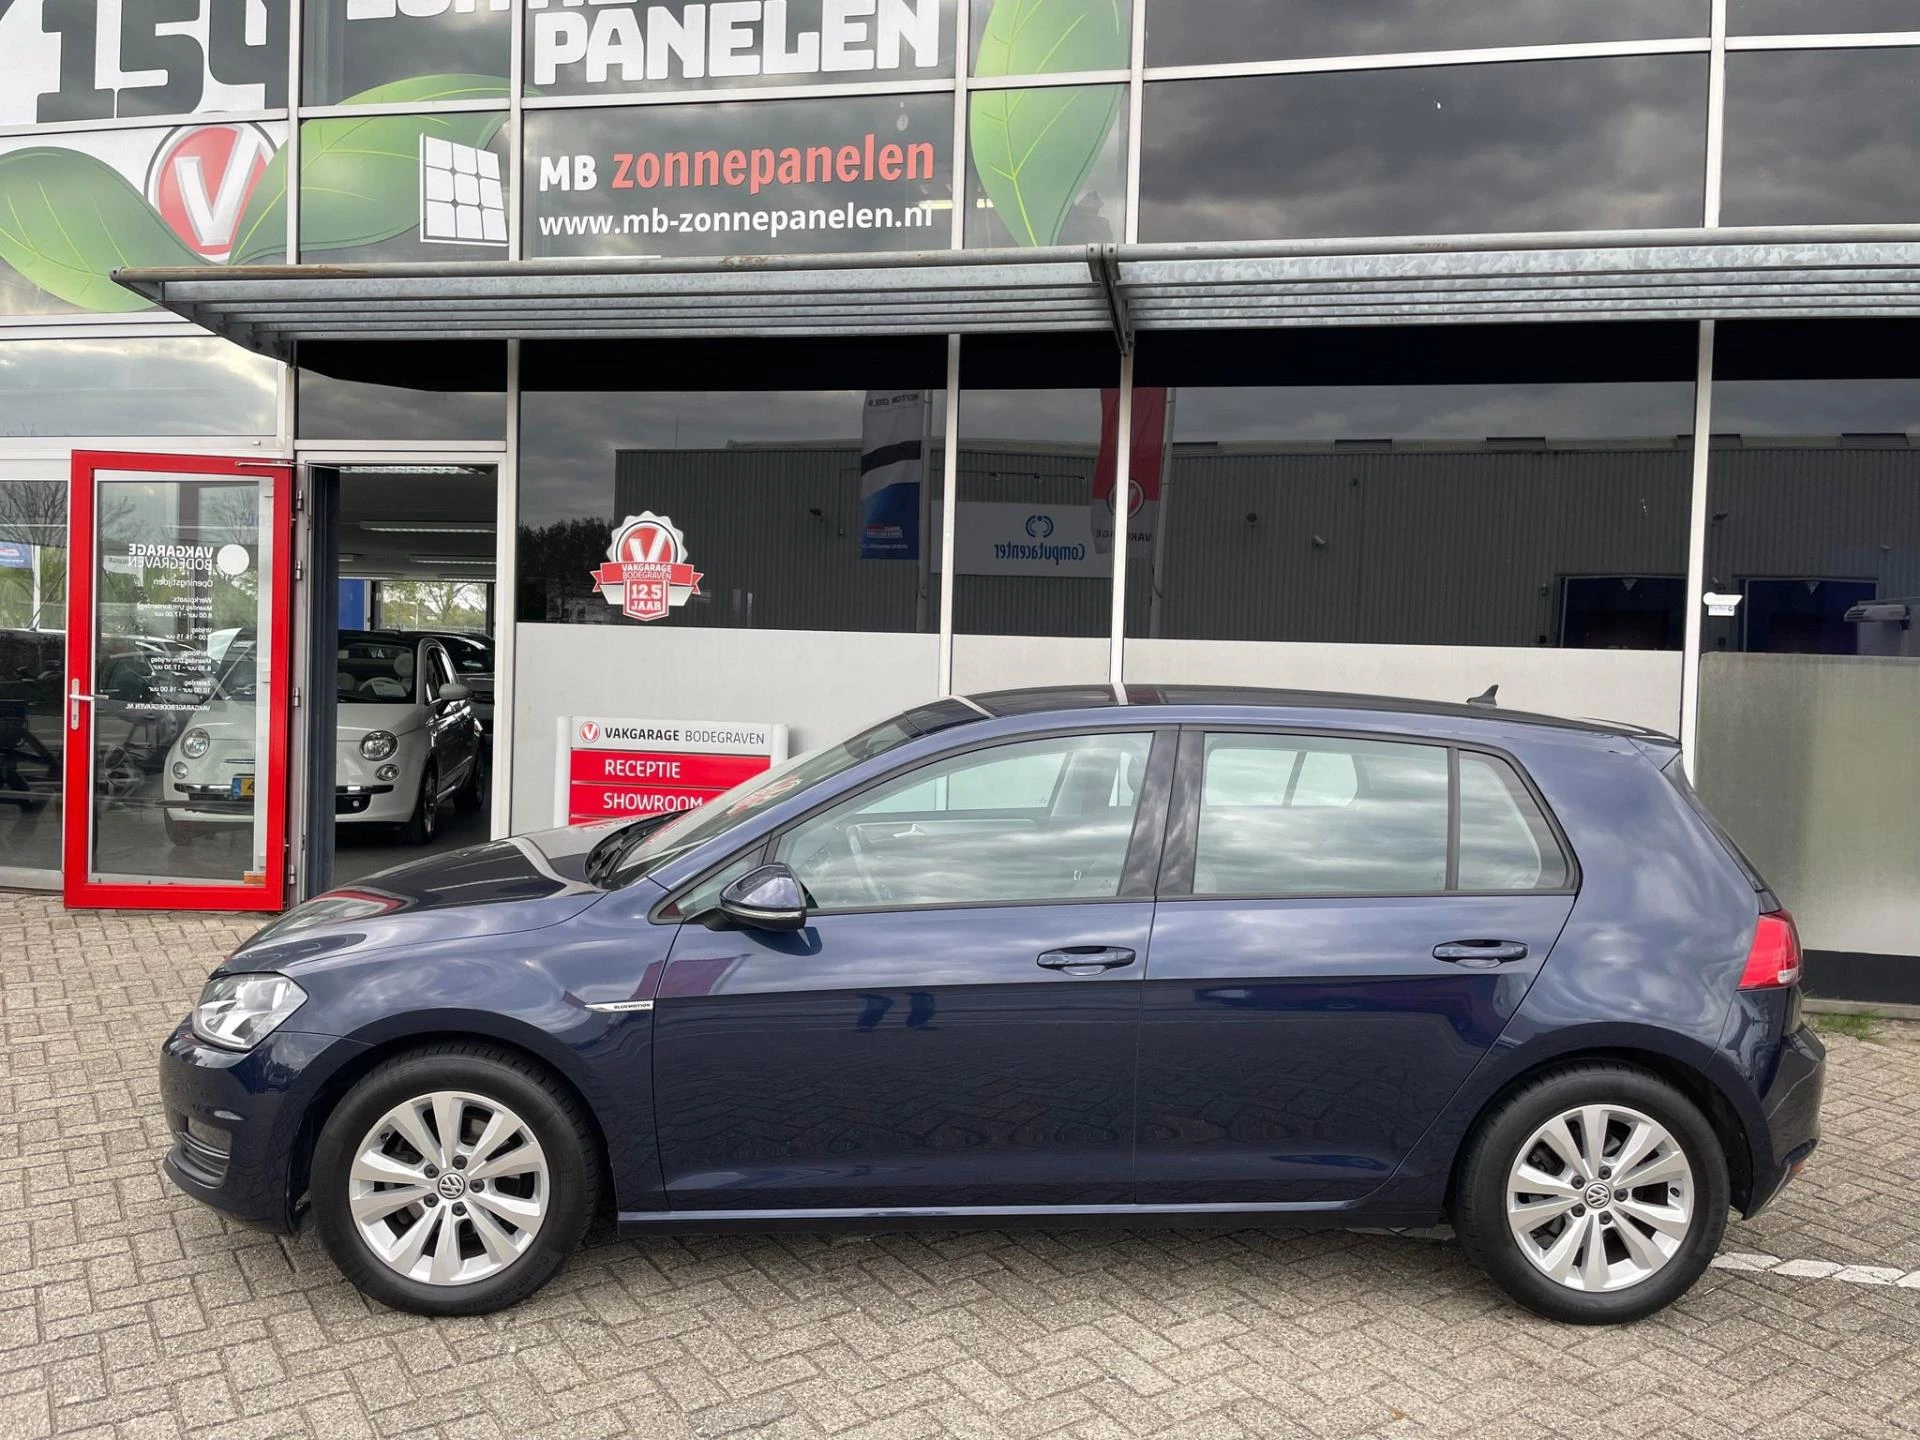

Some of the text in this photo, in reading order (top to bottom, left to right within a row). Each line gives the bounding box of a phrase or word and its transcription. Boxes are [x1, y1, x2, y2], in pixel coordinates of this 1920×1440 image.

[534, 0, 939, 86] PANELEN
[539, 133, 934, 196] MB zonnepanelen
[539, 201, 933, 238] www.mb-zonnepanelen.nl
[622, 563, 672, 573] VAKGARAGE
[622, 571, 672, 580] BODEGRAVEN
[631, 600, 662, 611] JAAR
[605, 727, 765, 745] VAKGARAGE BODEGRAVEN
[604, 759, 681, 779] RECEPTIE
[602, 792, 703, 812] SHOWROOM
